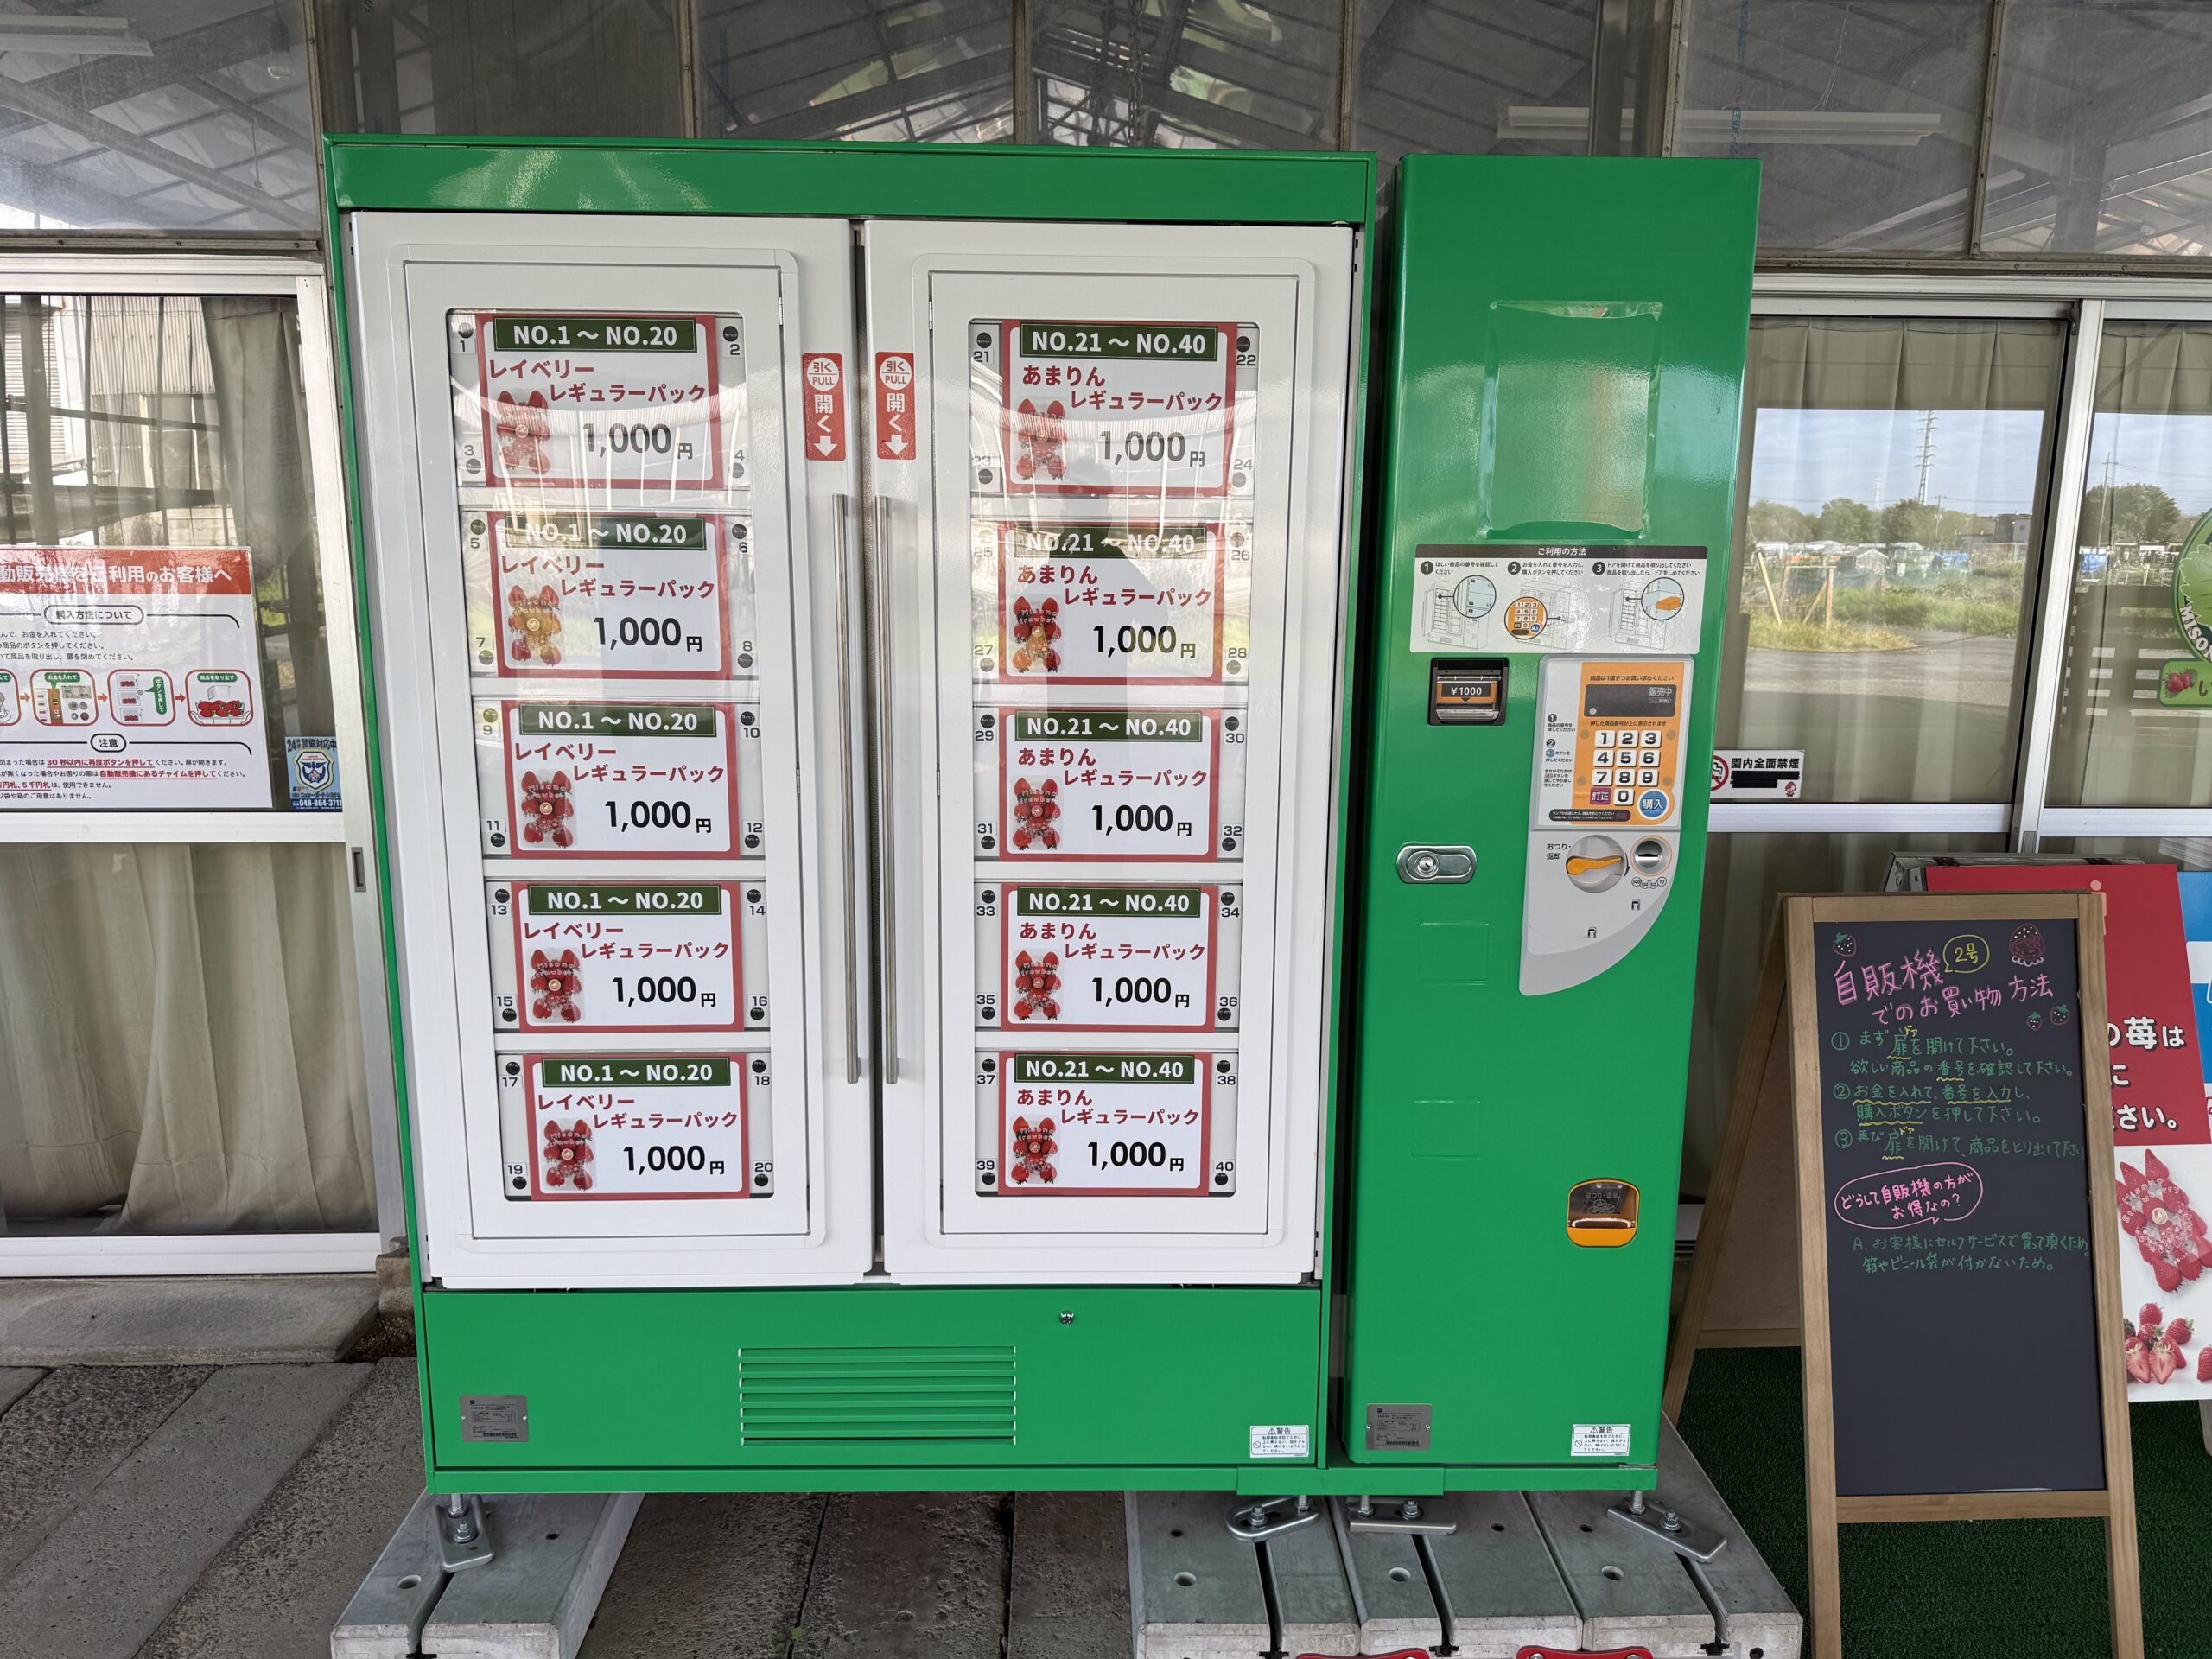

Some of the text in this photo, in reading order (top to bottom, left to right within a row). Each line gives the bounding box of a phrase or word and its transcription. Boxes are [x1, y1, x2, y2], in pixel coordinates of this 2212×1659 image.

[460, 340, 466, 352] 1
[729, 344, 741, 355] 2
[974, 352, 989, 363] 21
[1236, 354, 1257, 366] 22
[490, 359, 594, 379] レイベリー
[813, 362, 832, 373] 引く
[886, 360, 905, 372] 引く
[812, 377, 835, 385] PULL
[886, 375, 907, 385] PULL
[1022, 365, 1106, 387] あまりん
[550, 383, 705, 403] レギュラーパック
[1071, 390, 1223, 412] レギュラーパック
[814, 394, 834, 434] 開く
[887, 392, 906, 432] 開く
[464, 444, 474, 456] 3
[734, 450, 745, 461] 4
[1233, 459, 1254, 470] 24
[470, 538, 480, 550] 5
[739, 542, 748, 553] 6
[1231, 550, 1250, 561] 26
[1538, 548, 1586, 556] ご利用の方法
[501, 556, 605, 575] レイベリー
[1017, 565, 1098, 586] あまりん
[561, 579, 715, 598] レギュラーパック
[1065, 588, 1211, 607] レギュラーパック
[56, 610, 132, 620] 購入方法について
[475, 637, 486, 648] 7
[742, 640, 752, 652] 8
[975, 645, 994, 656] 27
[1228, 647, 1247, 658] 28
[1649, 687, 1673, 697] 販売中
[483, 725, 493, 735] 9
[743, 728, 760, 739] 10
[975, 731, 994, 741] 29
[1226, 733, 1244, 744] 30
[1601, 733, 1607, 745] 1
[1622, 733, 1633, 745] 2
[1644, 733, 1656, 745] 3
[99, 739, 118, 747] 注意
[515, 742, 617, 760] レイベリー
[1018, 747, 1096, 766] あまりん
[1597, 752, 1609, 764] 4
[1620, 752, 1631, 764] 5
[1643, 752, 1655, 764] 6
[1731, 758, 1800, 769] 園内全面禁煙
[574, 764, 725, 784] レギュラーパック
[1064, 769, 1208, 787] レギュラーパック
[1596, 771, 1608, 784] 7
[1618, 771, 1630, 784] 8
[1642, 771, 1653, 784] 9
[1592, 791, 1609, 801] 訂正
[1618, 791, 1629, 803] 0
[1643, 799, 1663, 810] 購入
[486, 820, 499, 830] 11
[747, 823, 763, 833] 12
[977, 823, 993, 834] 31
[1224, 825, 1243, 836] 32
[492, 905, 507, 915] 13
[750, 906, 766, 916] 14
[976, 906, 995, 916] 33
[1221, 907, 1240, 918] 34
[524, 922, 624, 940] レイベリー
[1020, 922, 1097, 940] あまりん
[582, 942, 729, 960] レギュラーパック
[1065, 943, 1205, 961] レギュラーパック
[1955, 942, 1979, 964] 2号
[1833, 948, 1944, 1006] 自販機
[497, 996, 512, 1007] 15
[752, 996, 767, 1007] 16
[976, 995, 995, 1005] 35
[1219, 997, 1238, 1007] 36
[1904, 1026, 1918, 1038] ドア
[503, 1077, 518, 1087] 17
[754, 1076, 770, 1086] 18
[976, 1075, 995, 1085] 37
[1217, 1076, 1236, 1085] 38
[537, 1094, 635, 1110] レイベリー
[1017, 1089, 1093, 1106] あまりん
[594, 1112, 738, 1129] レギュラーパック
[1061, 1109, 1199, 1126] レギュラーパック
[2113, 1105, 2177, 1130] さい。
[1899, 1126, 1915, 1135] ドア
[507, 1165, 523, 1174] 19
[754, 1162, 773, 1173] 20
[976, 1160, 995, 1171] 39
[1215, 1161, 1234, 1172] 40
[1840, 1173, 1974, 1210] どうして自販機の方が
[1862, 1253, 2054, 1274] 箱やビニール袋が付かないため。
